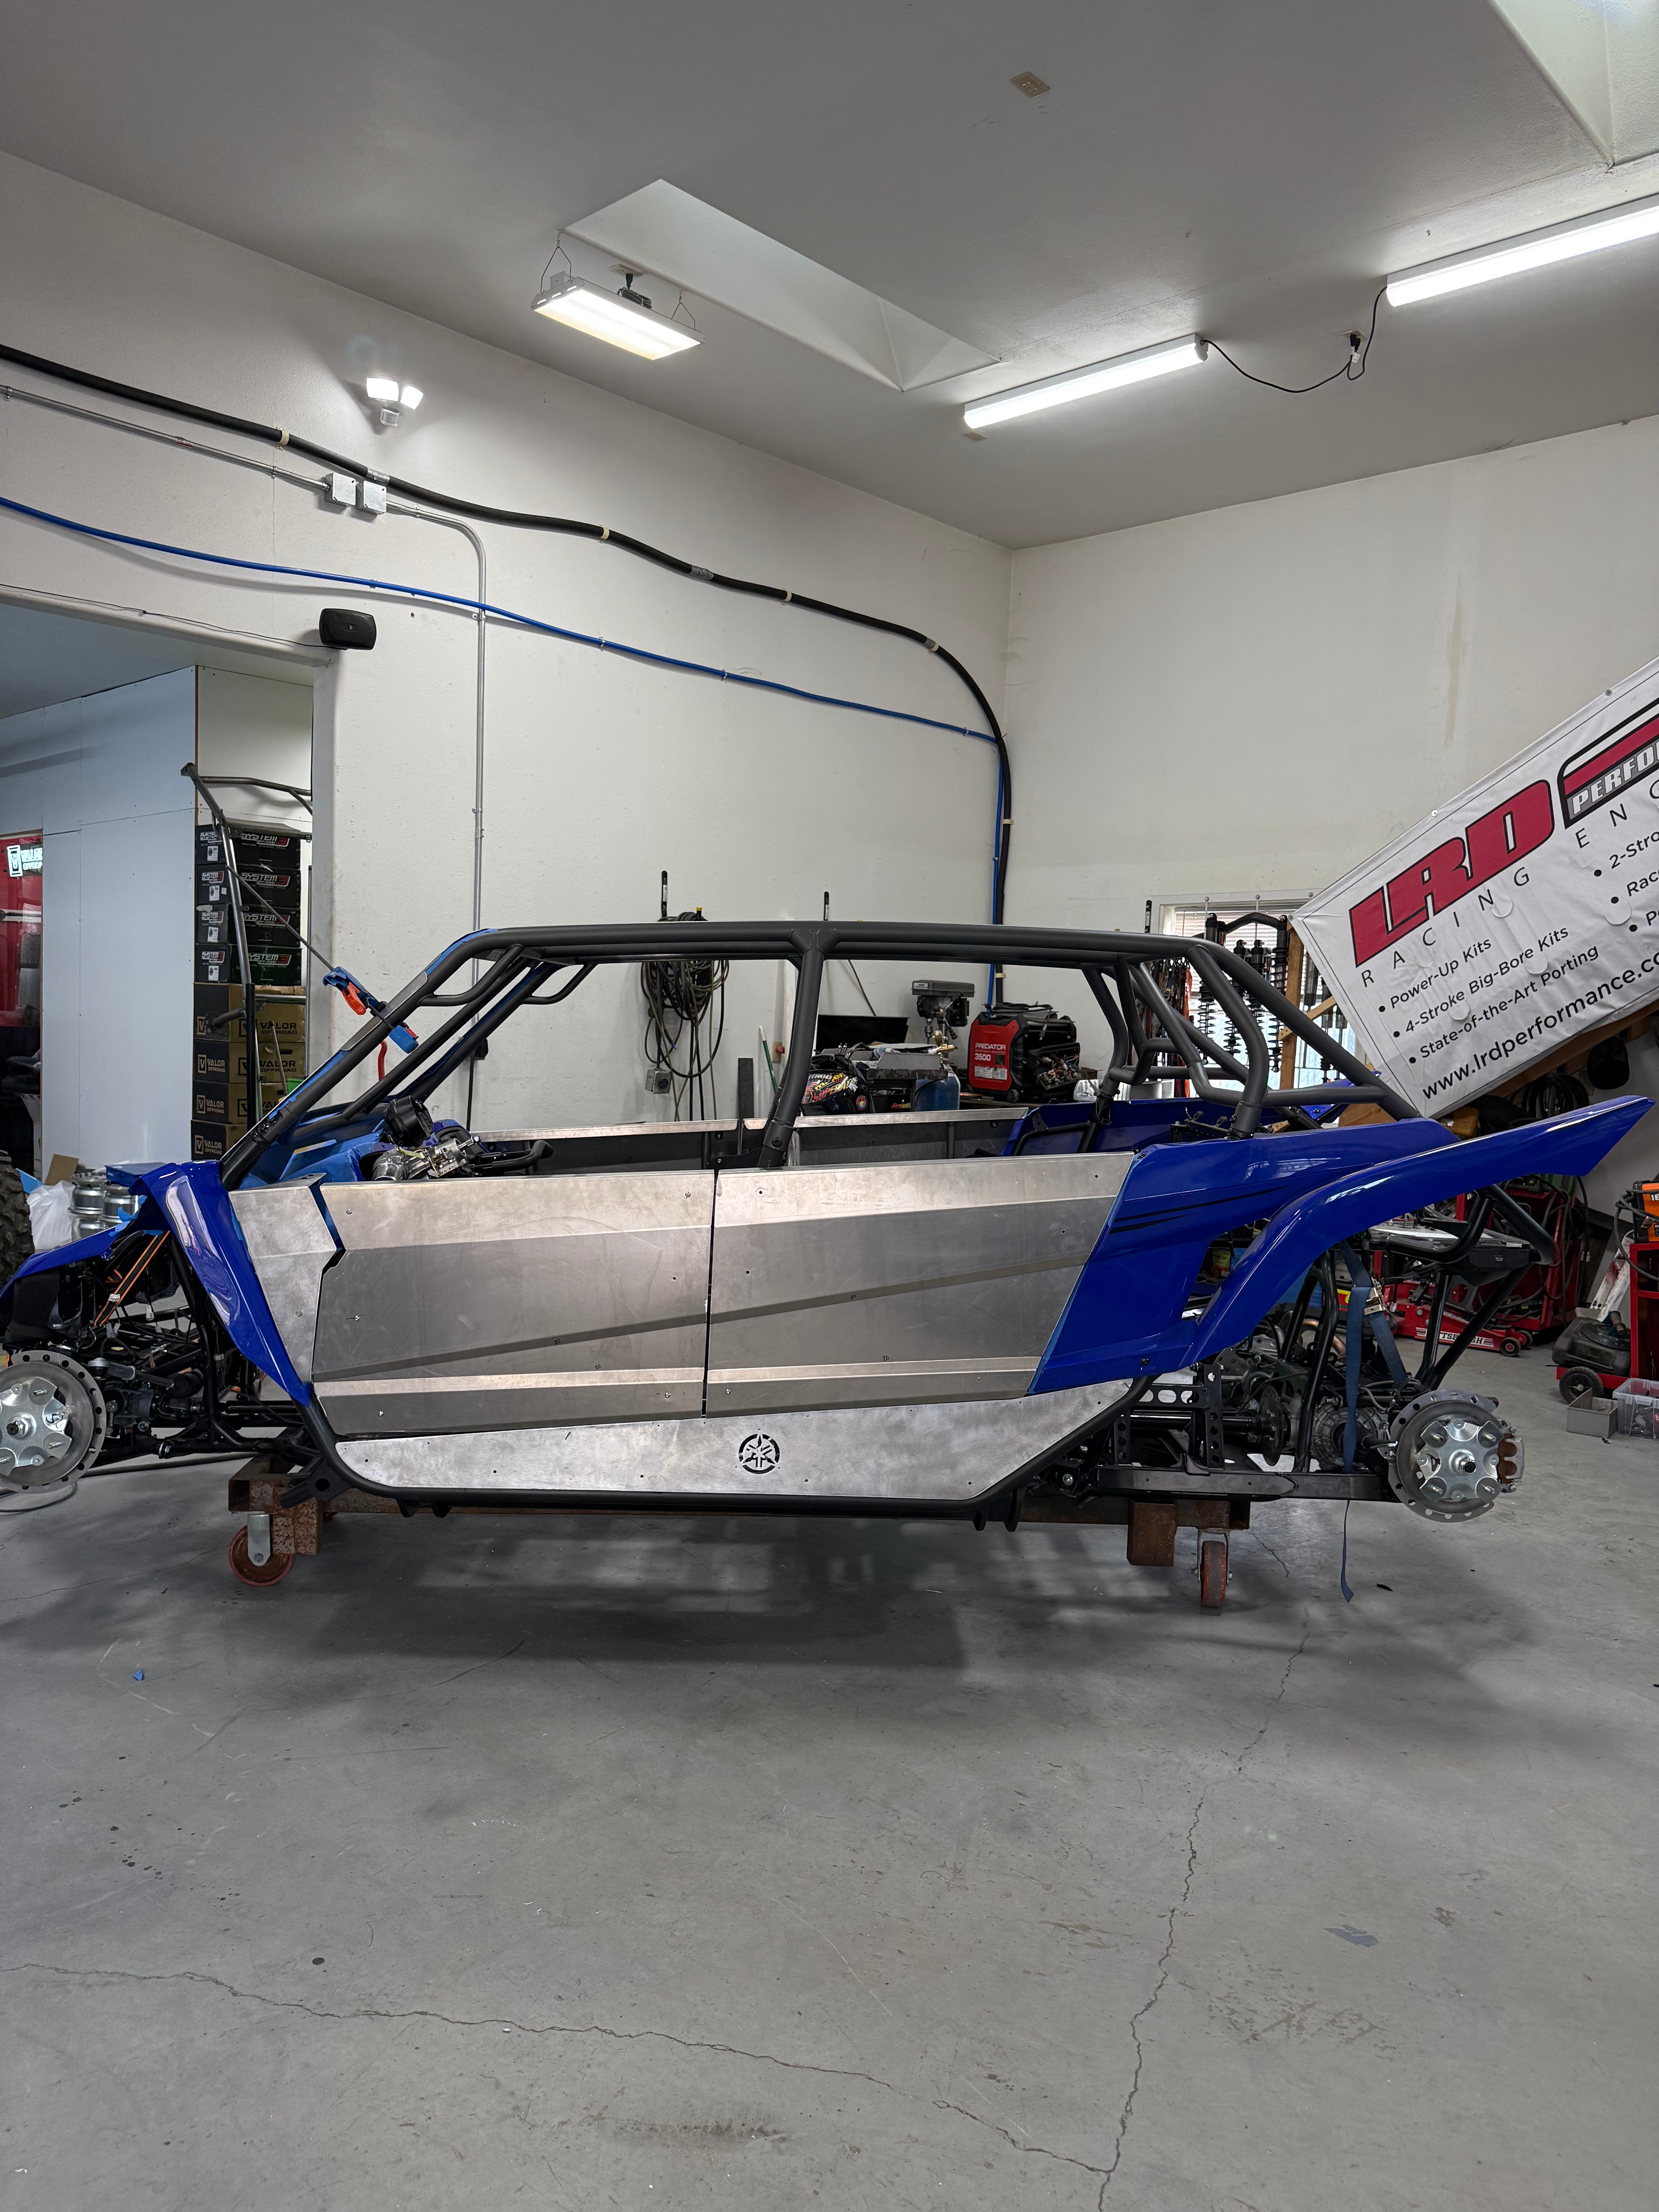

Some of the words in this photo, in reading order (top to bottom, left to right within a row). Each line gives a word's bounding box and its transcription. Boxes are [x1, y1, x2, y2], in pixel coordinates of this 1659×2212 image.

[1572, 741, 1659, 815] PERFO
[1609, 832, 1659, 869] 2-Stro
[241, 873, 277, 881] SYSTEM
[275, 876, 288, 886] 3
[1349, 780, 1555, 968] LRD
[1626, 869, 1659, 896] Rac
[1361, 867, 1529, 987] RACING
[1646, 910, 1659, 926] P
[276, 955, 289, 964] 3
[1390, 959, 1459, 1008] Power-Up
[1462, 939, 1491, 963] Kits
[1405, 991, 1465, 1032] 4-Stroke
[1468, 948, 1534, 994] Big-Bore
[1537, 927, 1569, 952] Kits
[1420, 981, 1538, 1058] State-of-the-Art
[1540, 946, 1598, 986] Porting
[207, 1059, 225, 1067] VALOR
[975, 1053, 991, 1061] 3500
[206, 1099, 224, 1108] VALOR
[204, 1140, 222, 1149] VALOR
